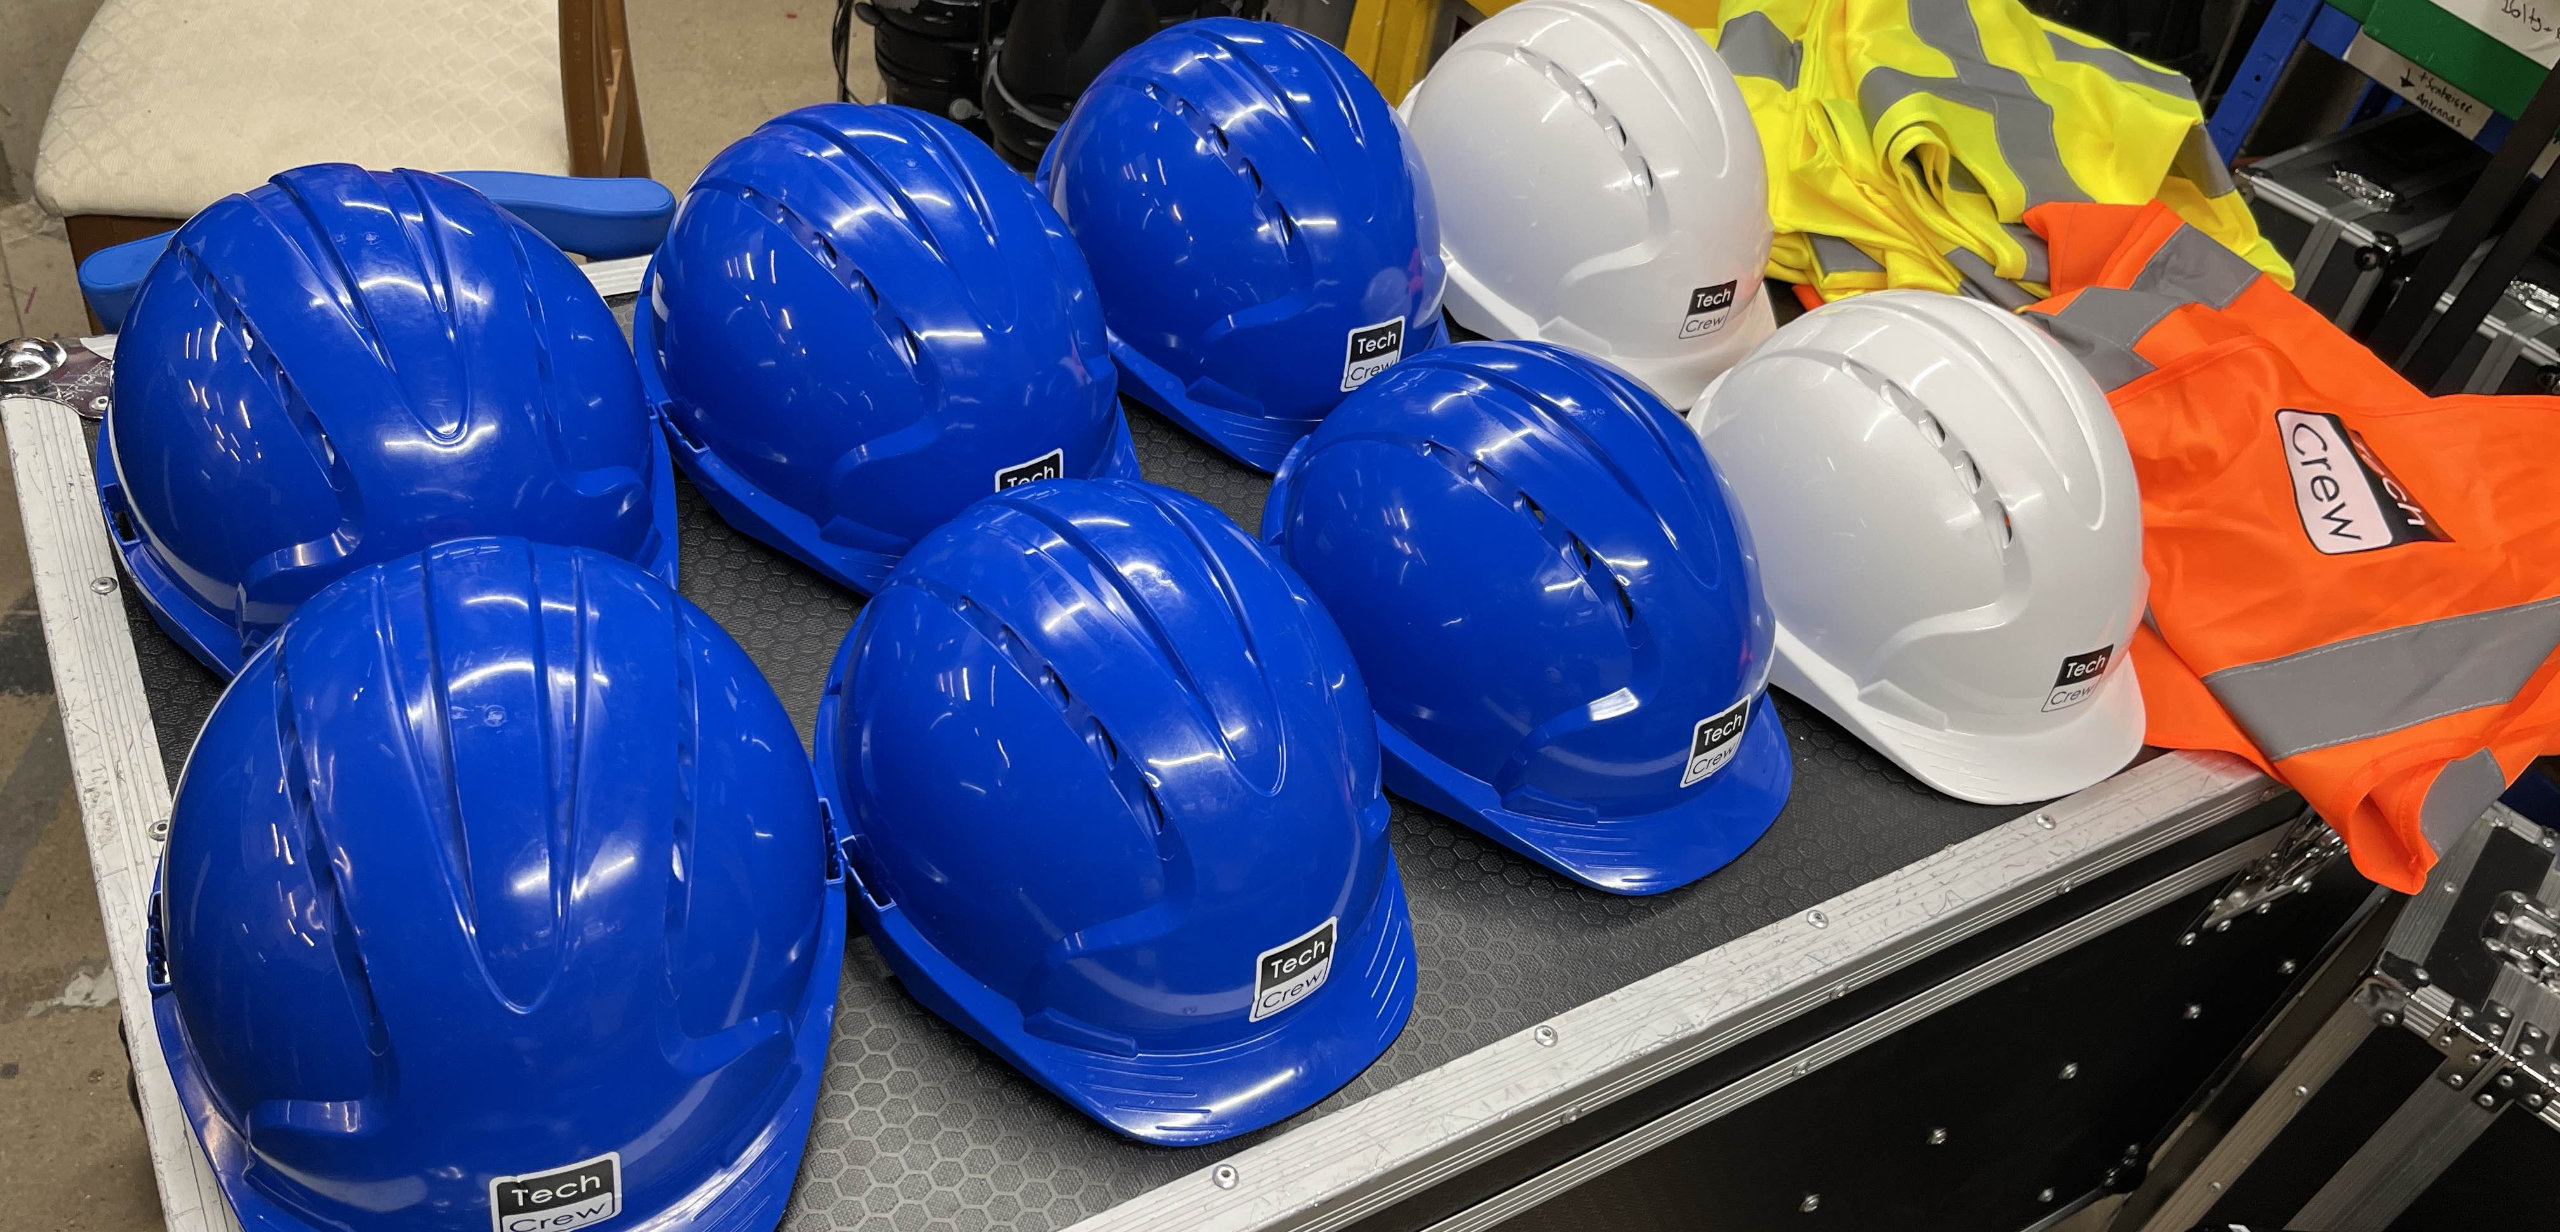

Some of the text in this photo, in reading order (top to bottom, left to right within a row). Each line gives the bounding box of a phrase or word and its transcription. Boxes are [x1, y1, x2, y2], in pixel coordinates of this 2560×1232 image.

[2416, 92, 2462, 127] Antennas
[1696, 288, 1731, 309] Tech
[1685, 314, 1726, 333] Crew
[1357, 330, 1397, 355] Tech
[2292, 423, 2362, 540] Crew
[2066, 654, 2106, 679] Tech
[2050, 683, 2096, 706] Crew
[1703, 713, 1742, 746] Tech
[1692, 743, 1736, 775] Crew
[1270, 940, 1325, 979] Tech
[1262, 969, 1323, 1008] Crew
[511, 1175, 601, 1207] Tech
[509, 1202, 606, 1232] Crew
